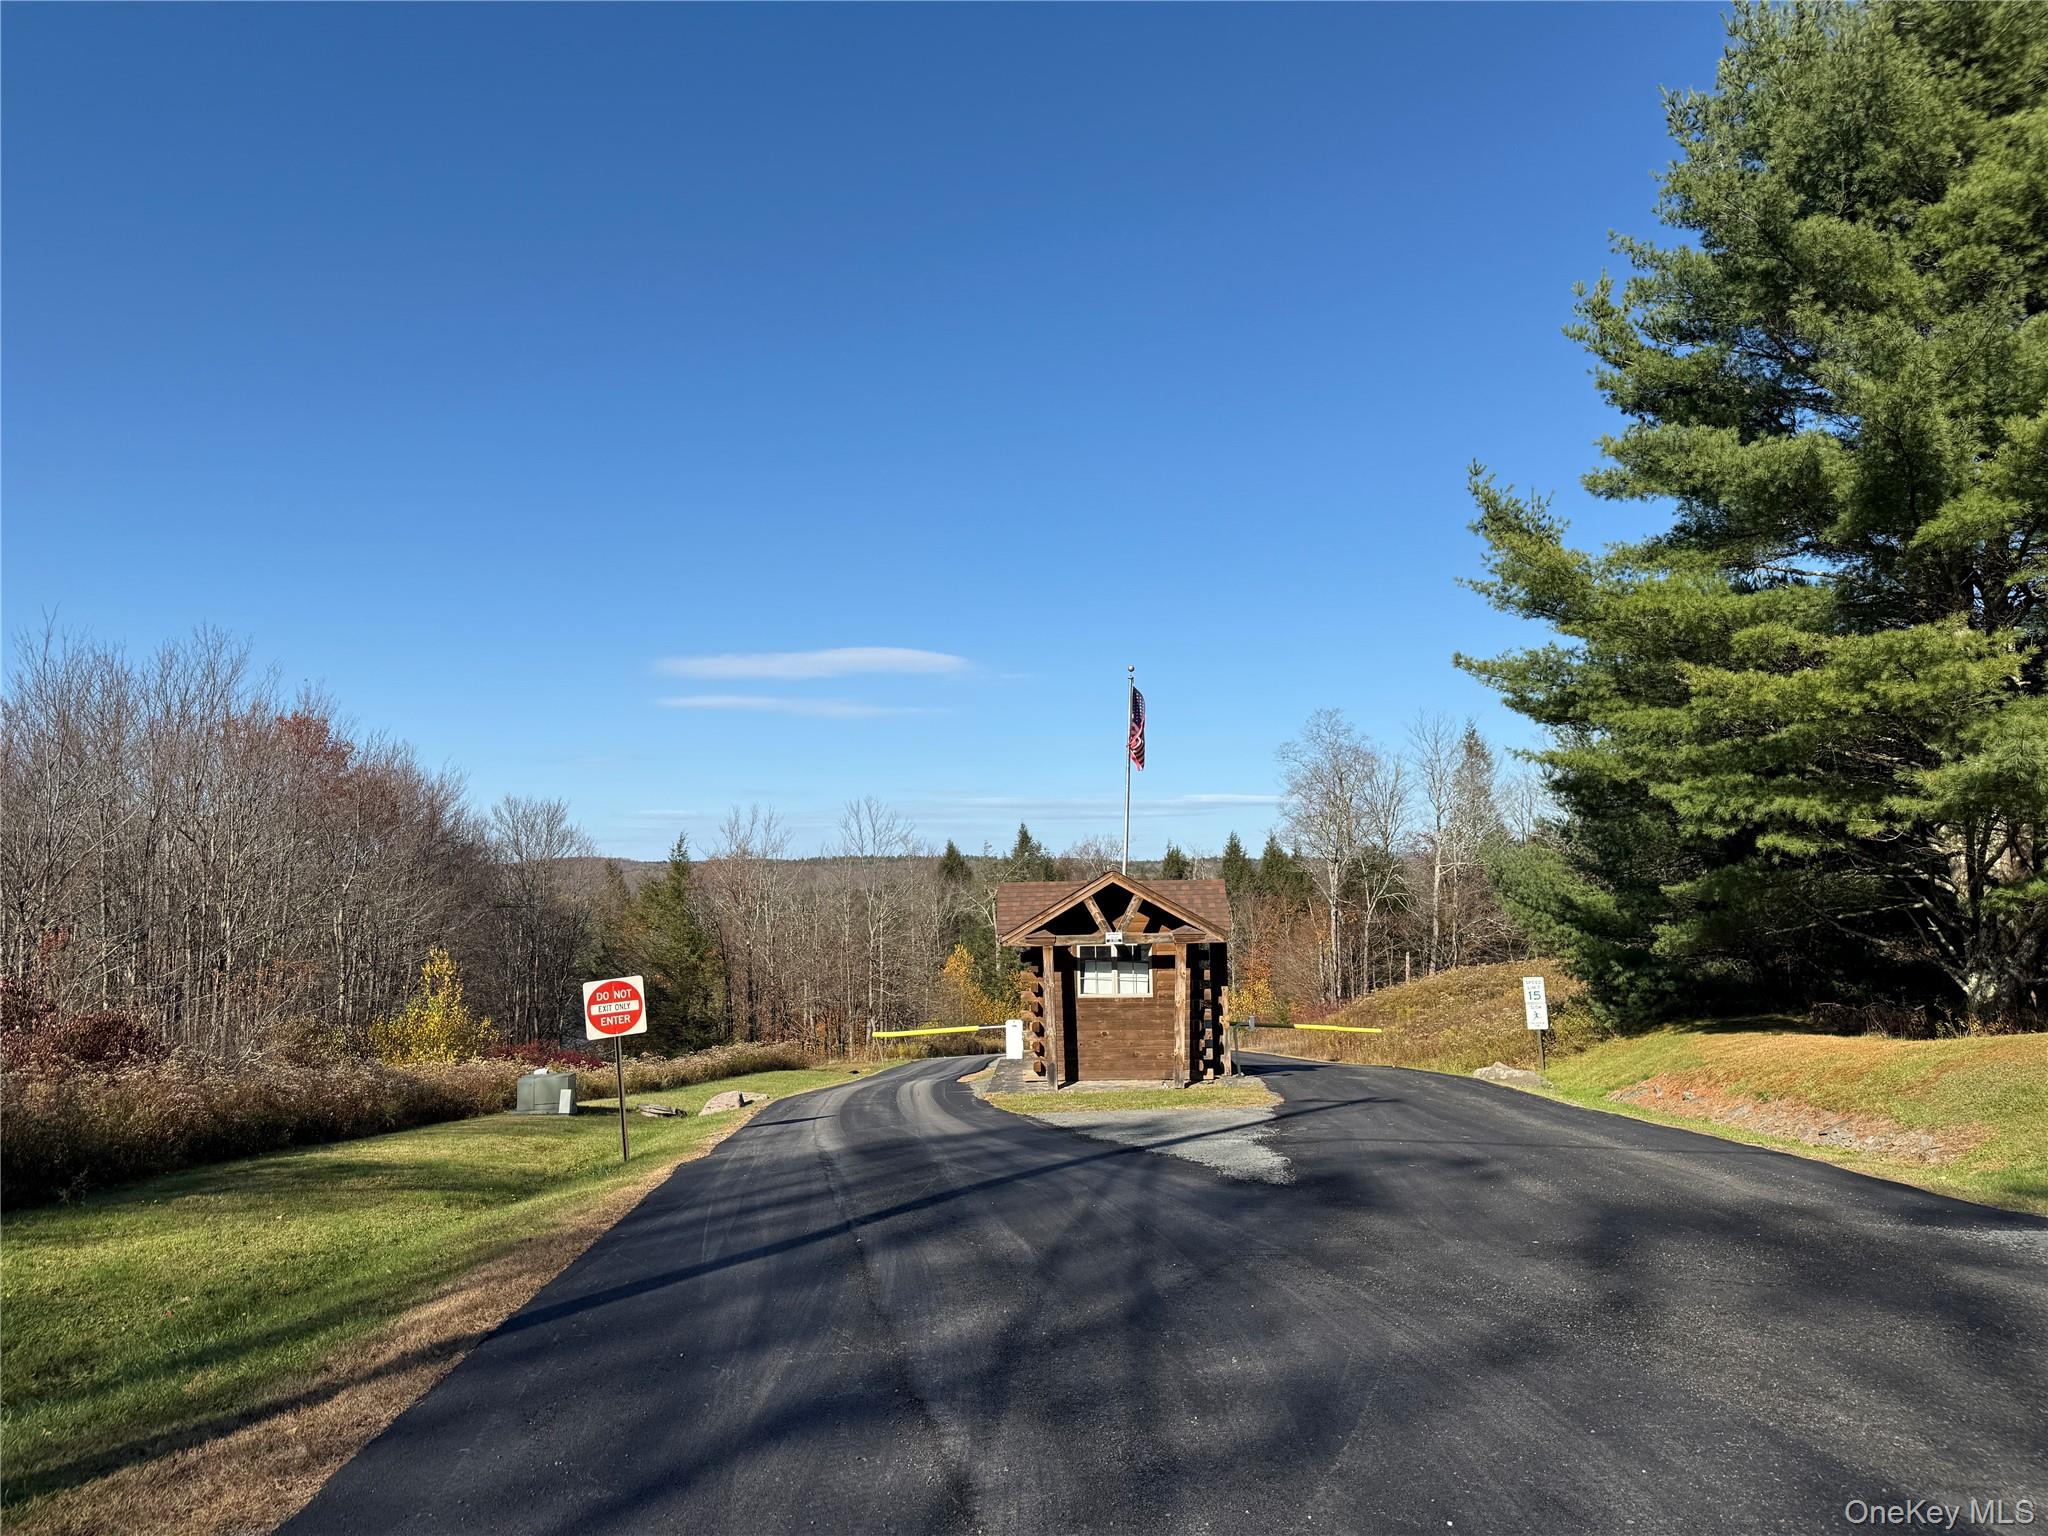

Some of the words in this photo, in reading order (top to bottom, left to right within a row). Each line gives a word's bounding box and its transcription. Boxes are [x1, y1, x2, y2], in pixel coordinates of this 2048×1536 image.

[596, 992, 609, 1001] DO
[613, 989, 632, 999] NOT
[1528, 990, 1542, 1000] 15
[598, 1004, 612, 1013] EXIT
[614, 1002, 631, 1011] ONLY
[600, 1015, 631, 1026] ENTER
